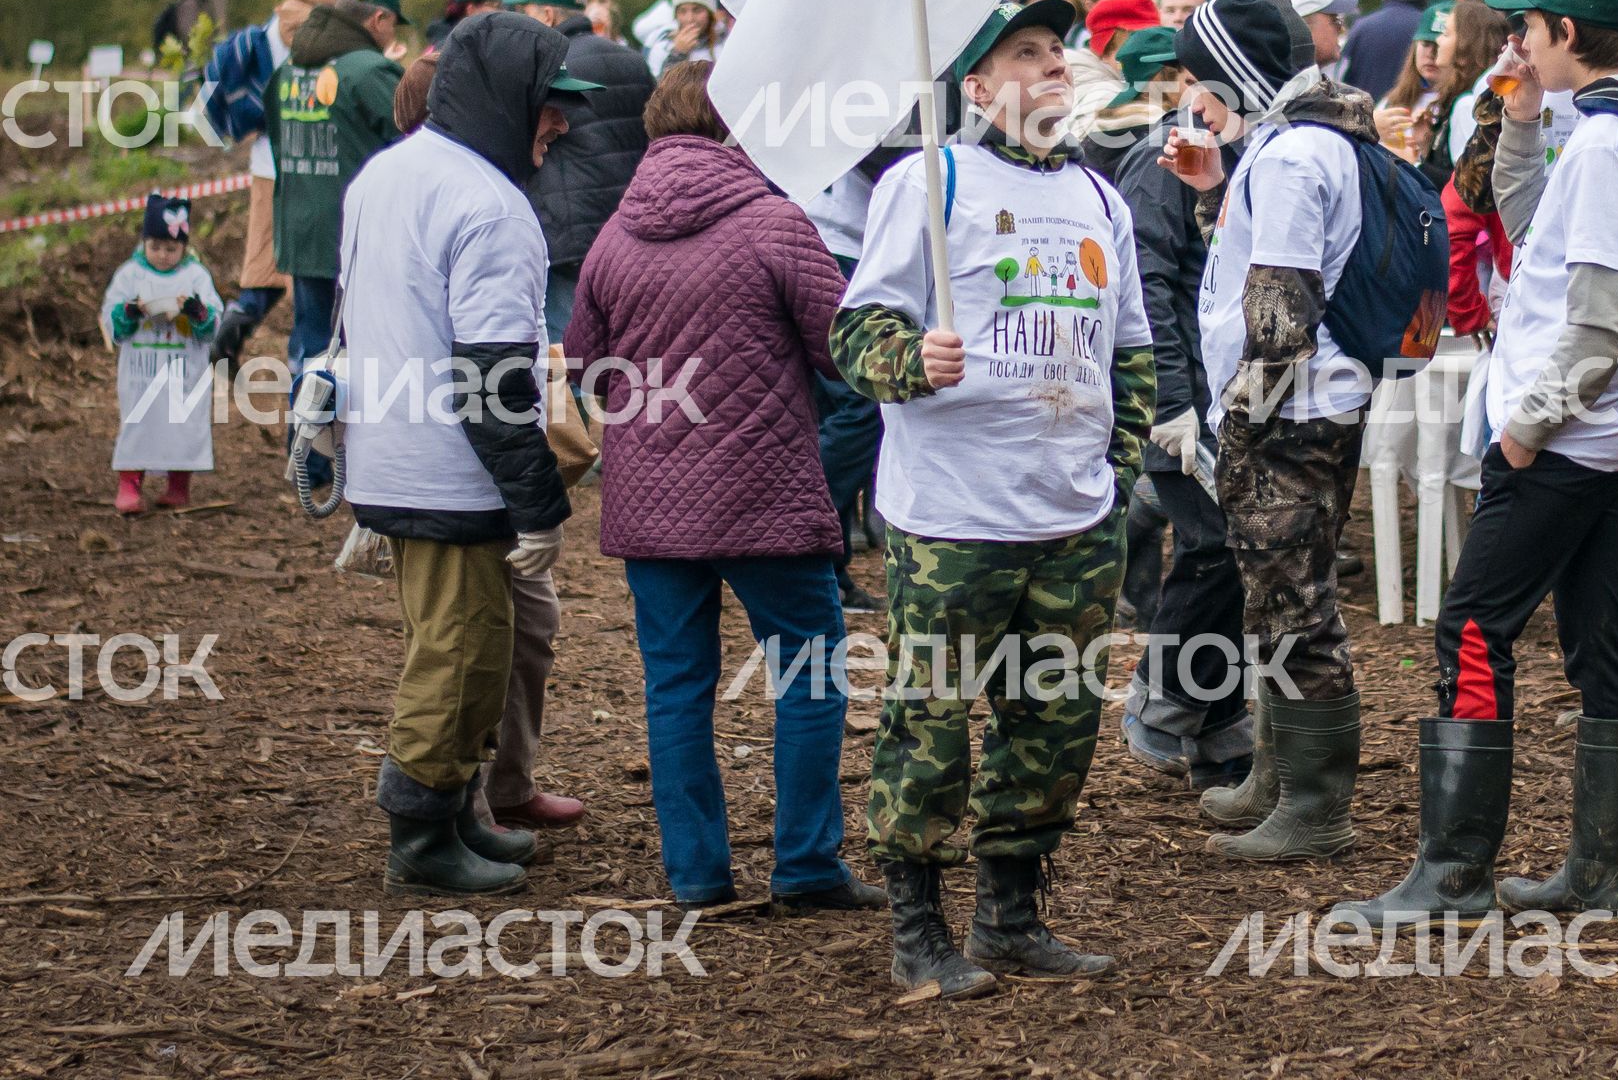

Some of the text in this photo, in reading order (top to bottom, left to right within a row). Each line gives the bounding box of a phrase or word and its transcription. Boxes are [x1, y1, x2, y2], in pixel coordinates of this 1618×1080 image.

[993, 309, 1055, 357] НАШ
[989, 361, 1035, 379] ПОСАДИ
[1044, 363, 1068, 381] СВОЕ
